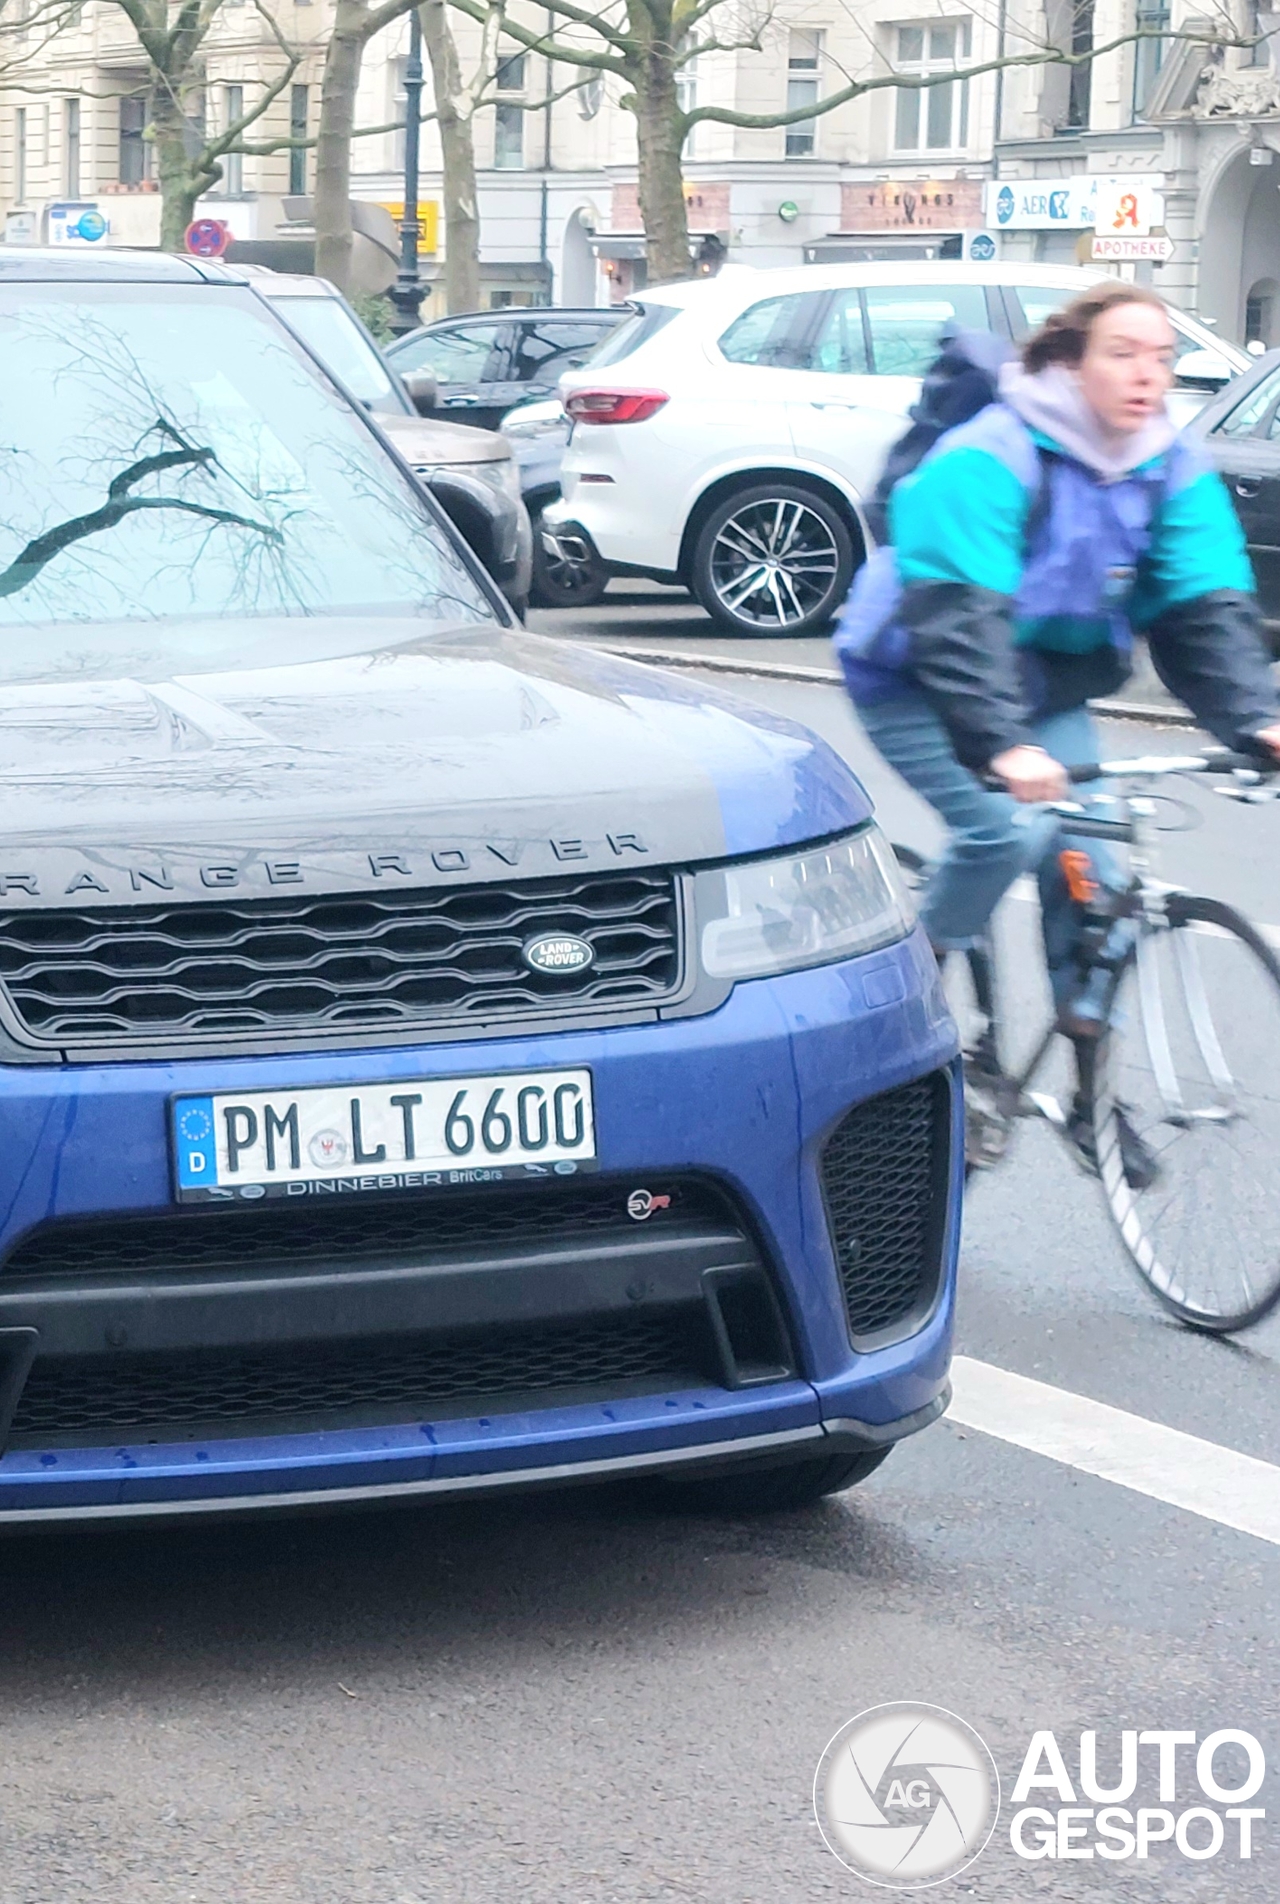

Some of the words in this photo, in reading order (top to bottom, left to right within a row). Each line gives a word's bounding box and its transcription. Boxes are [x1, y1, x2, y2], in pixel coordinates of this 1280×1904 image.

[1094, 241, 1166, 255] APOTHEKE
[368, 832, 650, 877] ROVER
[540, 942, 573, 955] LAND
[545, 952, 584, 966] ROVER
[224, 1102, 300, 1172] PM
[351, 1093, 423, 1164] LT
[444, 1082, 585, 1156] 6600
[189, 1151, 206, 1173] D
[287, 1171, 442, 1196] DINNEBIER
[449, 1168, 503, 1183] BritCars
